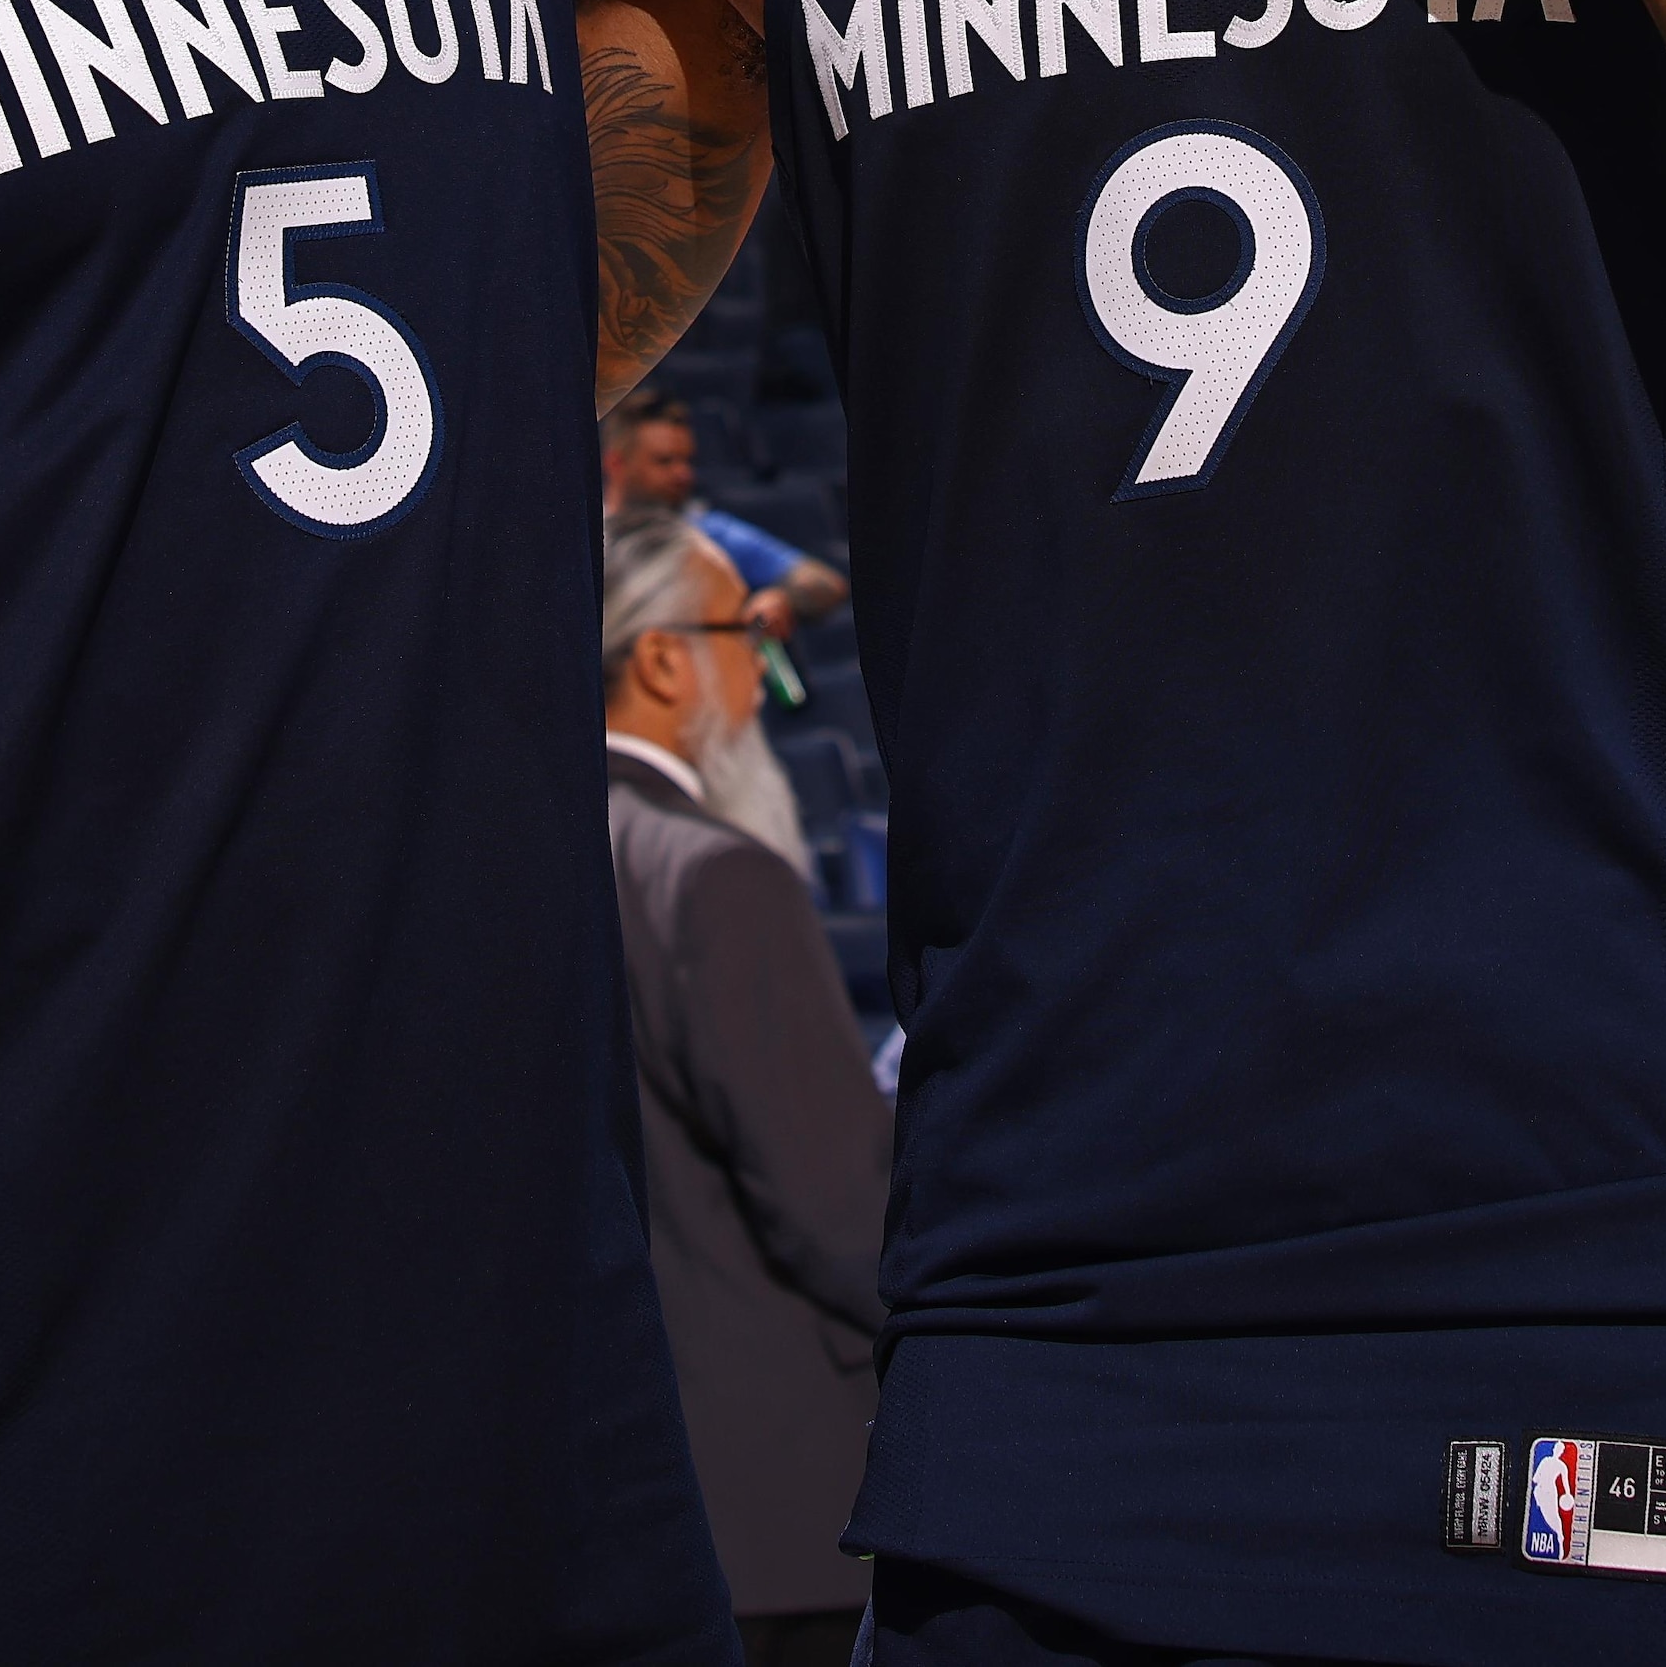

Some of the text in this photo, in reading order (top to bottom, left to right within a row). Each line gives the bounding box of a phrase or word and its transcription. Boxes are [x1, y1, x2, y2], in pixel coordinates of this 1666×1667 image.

[1074, 118, 1328, 503] 9
[226, 160, 447, 540] 5
[1655, 1478, 1664, 1486] OF
[1656, 1469, 1665, 1477] TO
[1609, 1476, 1635, 1498] 46
[1572, 1442, 1593, 1561] AUTHENTICS
[1531, 1532, 1554, 1553] NBA
